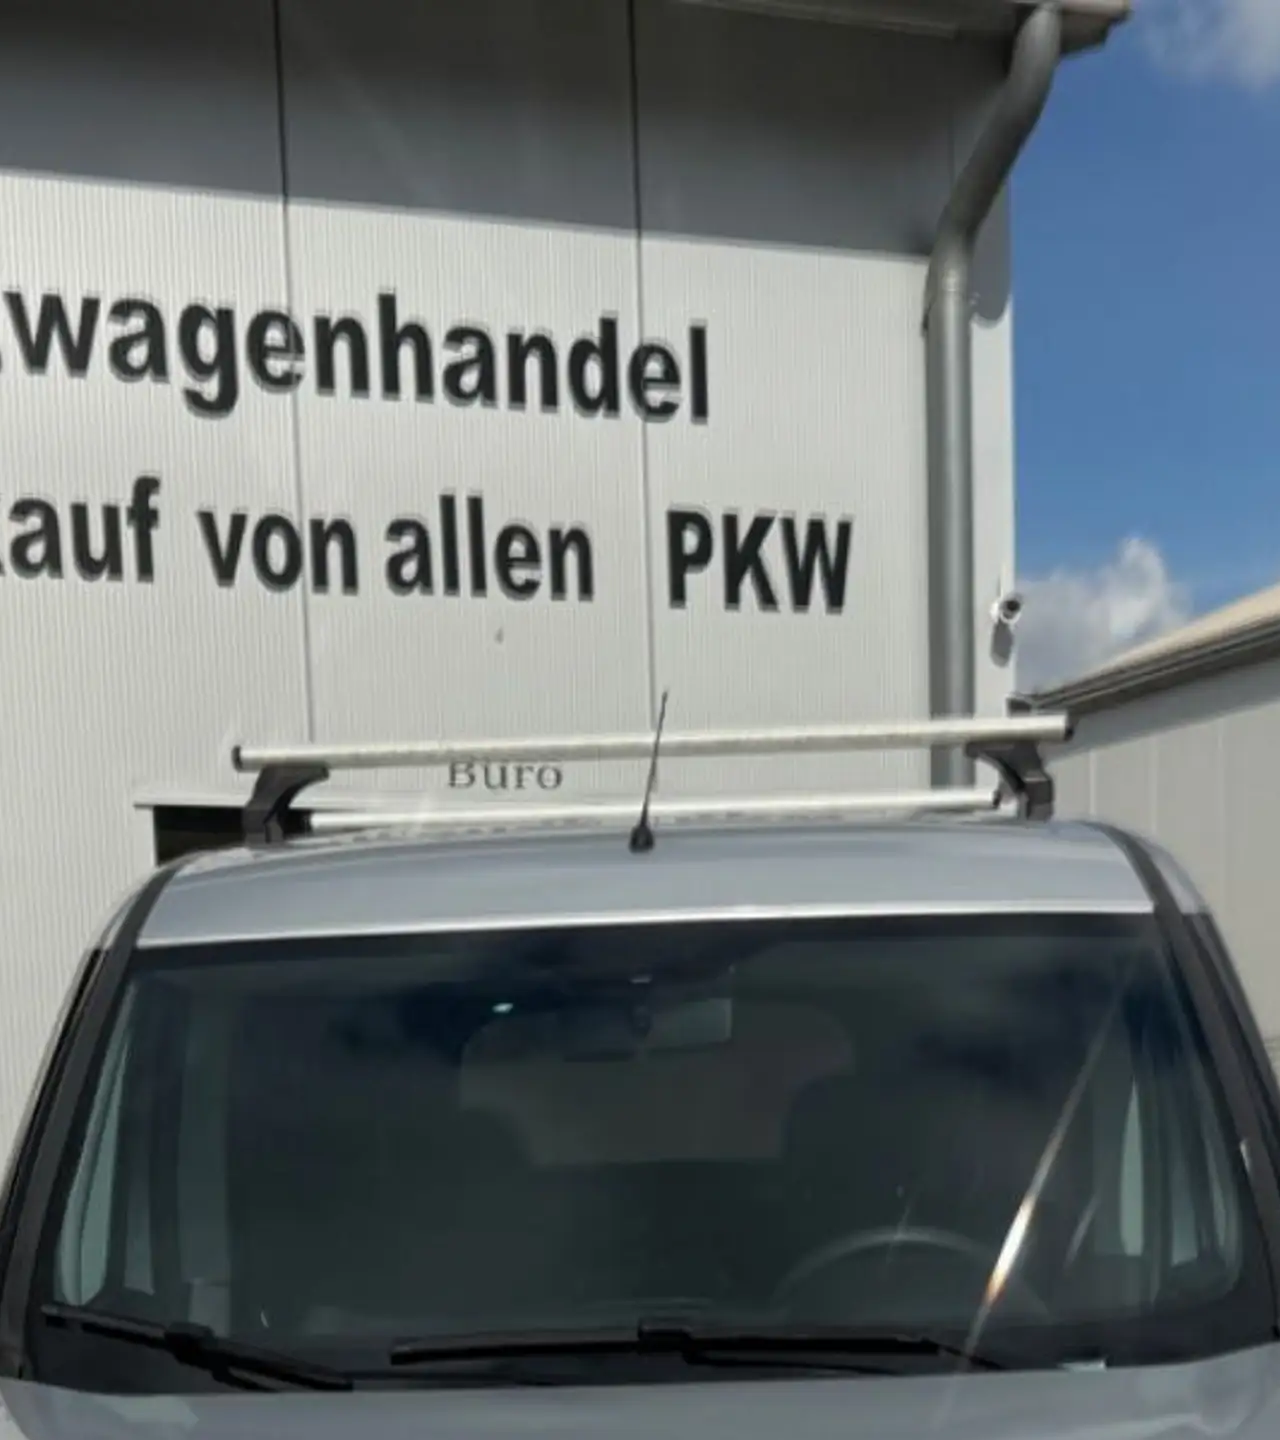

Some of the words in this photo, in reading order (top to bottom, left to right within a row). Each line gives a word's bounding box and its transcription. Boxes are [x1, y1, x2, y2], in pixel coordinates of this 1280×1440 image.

[197, 508, 360, 597] von
[384, 492, 595, 603] allen
[665, 507, 855, 615] PKW
